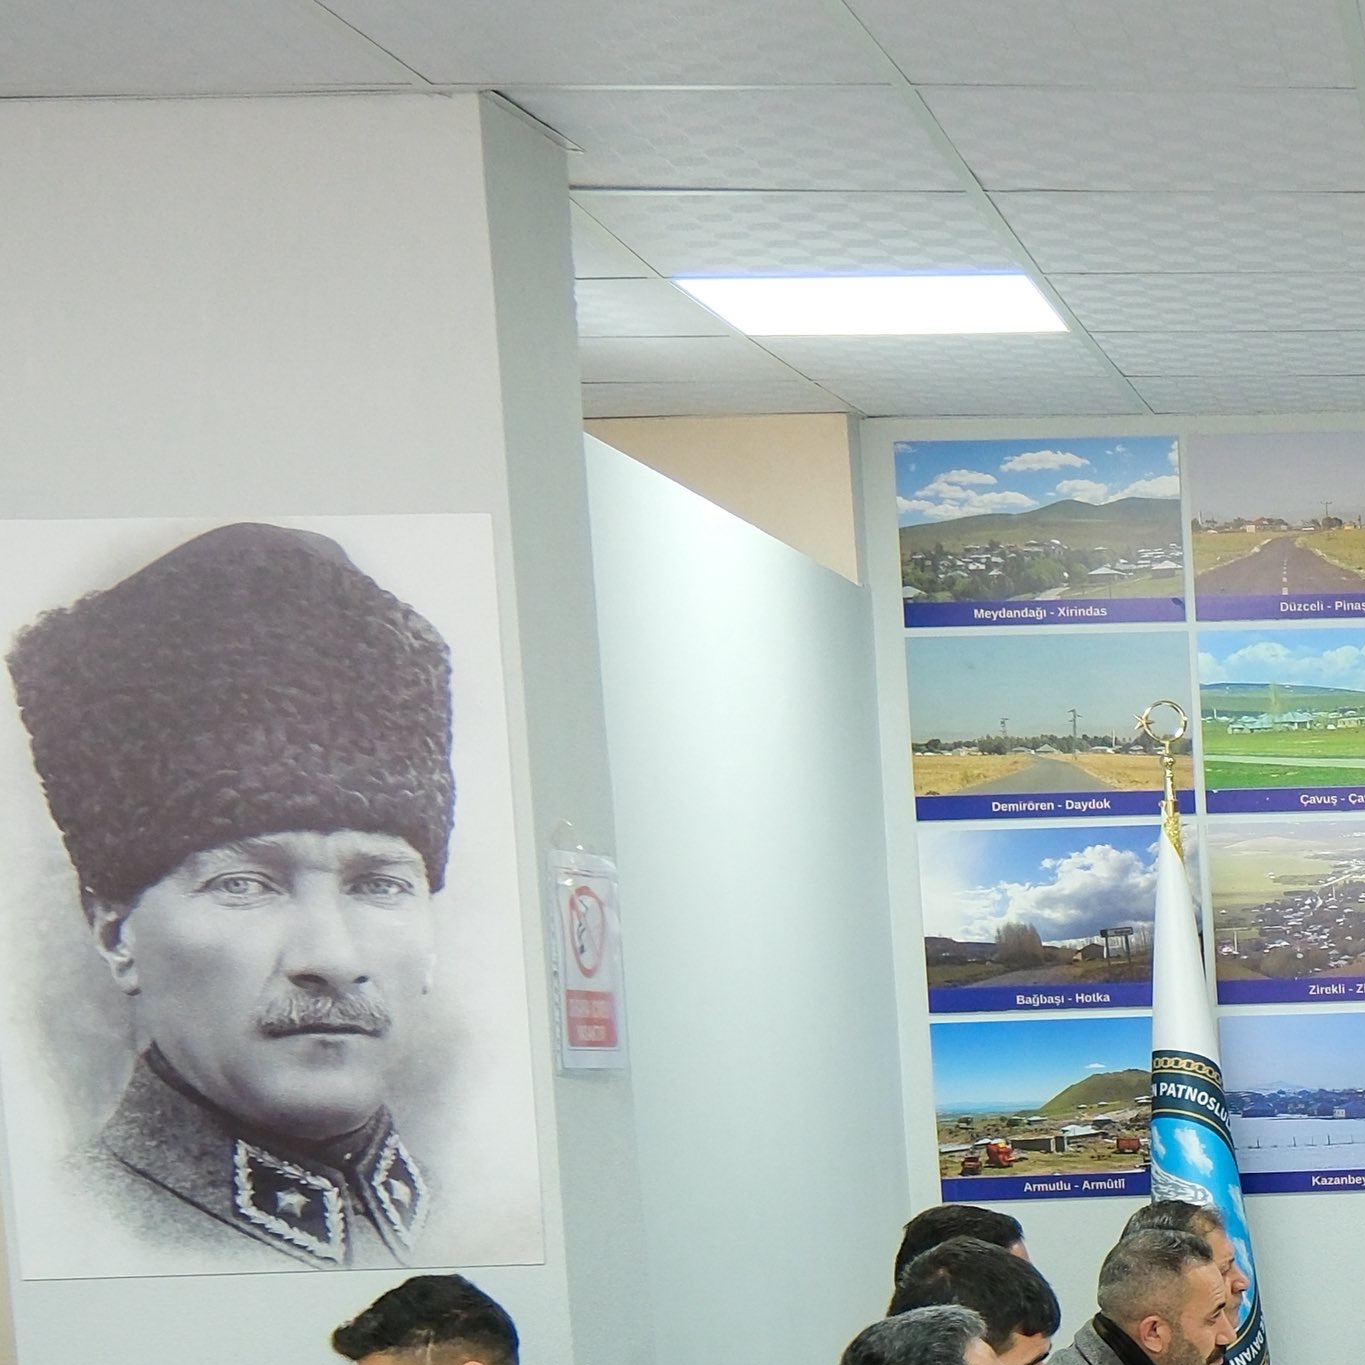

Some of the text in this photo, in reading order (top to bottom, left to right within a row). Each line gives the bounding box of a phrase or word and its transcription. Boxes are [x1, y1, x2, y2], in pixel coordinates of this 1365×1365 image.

[1280, 601, 1323, 611] Düzceli
[974, 608, 1046, 620] Meydandağı
[992, 801, 1054, 811] Demirören
[1066, 799, 1110, 811] Daydok
[1300, 795, 1337, 806] Çavuş
[1309, 984, 1345, 994] Zirekli
[1017, 994, 1064, 1006] Bağbaşı
[1076, 993, 1110, 1003] Hotka
[1024, 1181, 1071, 1191] Armutlu
